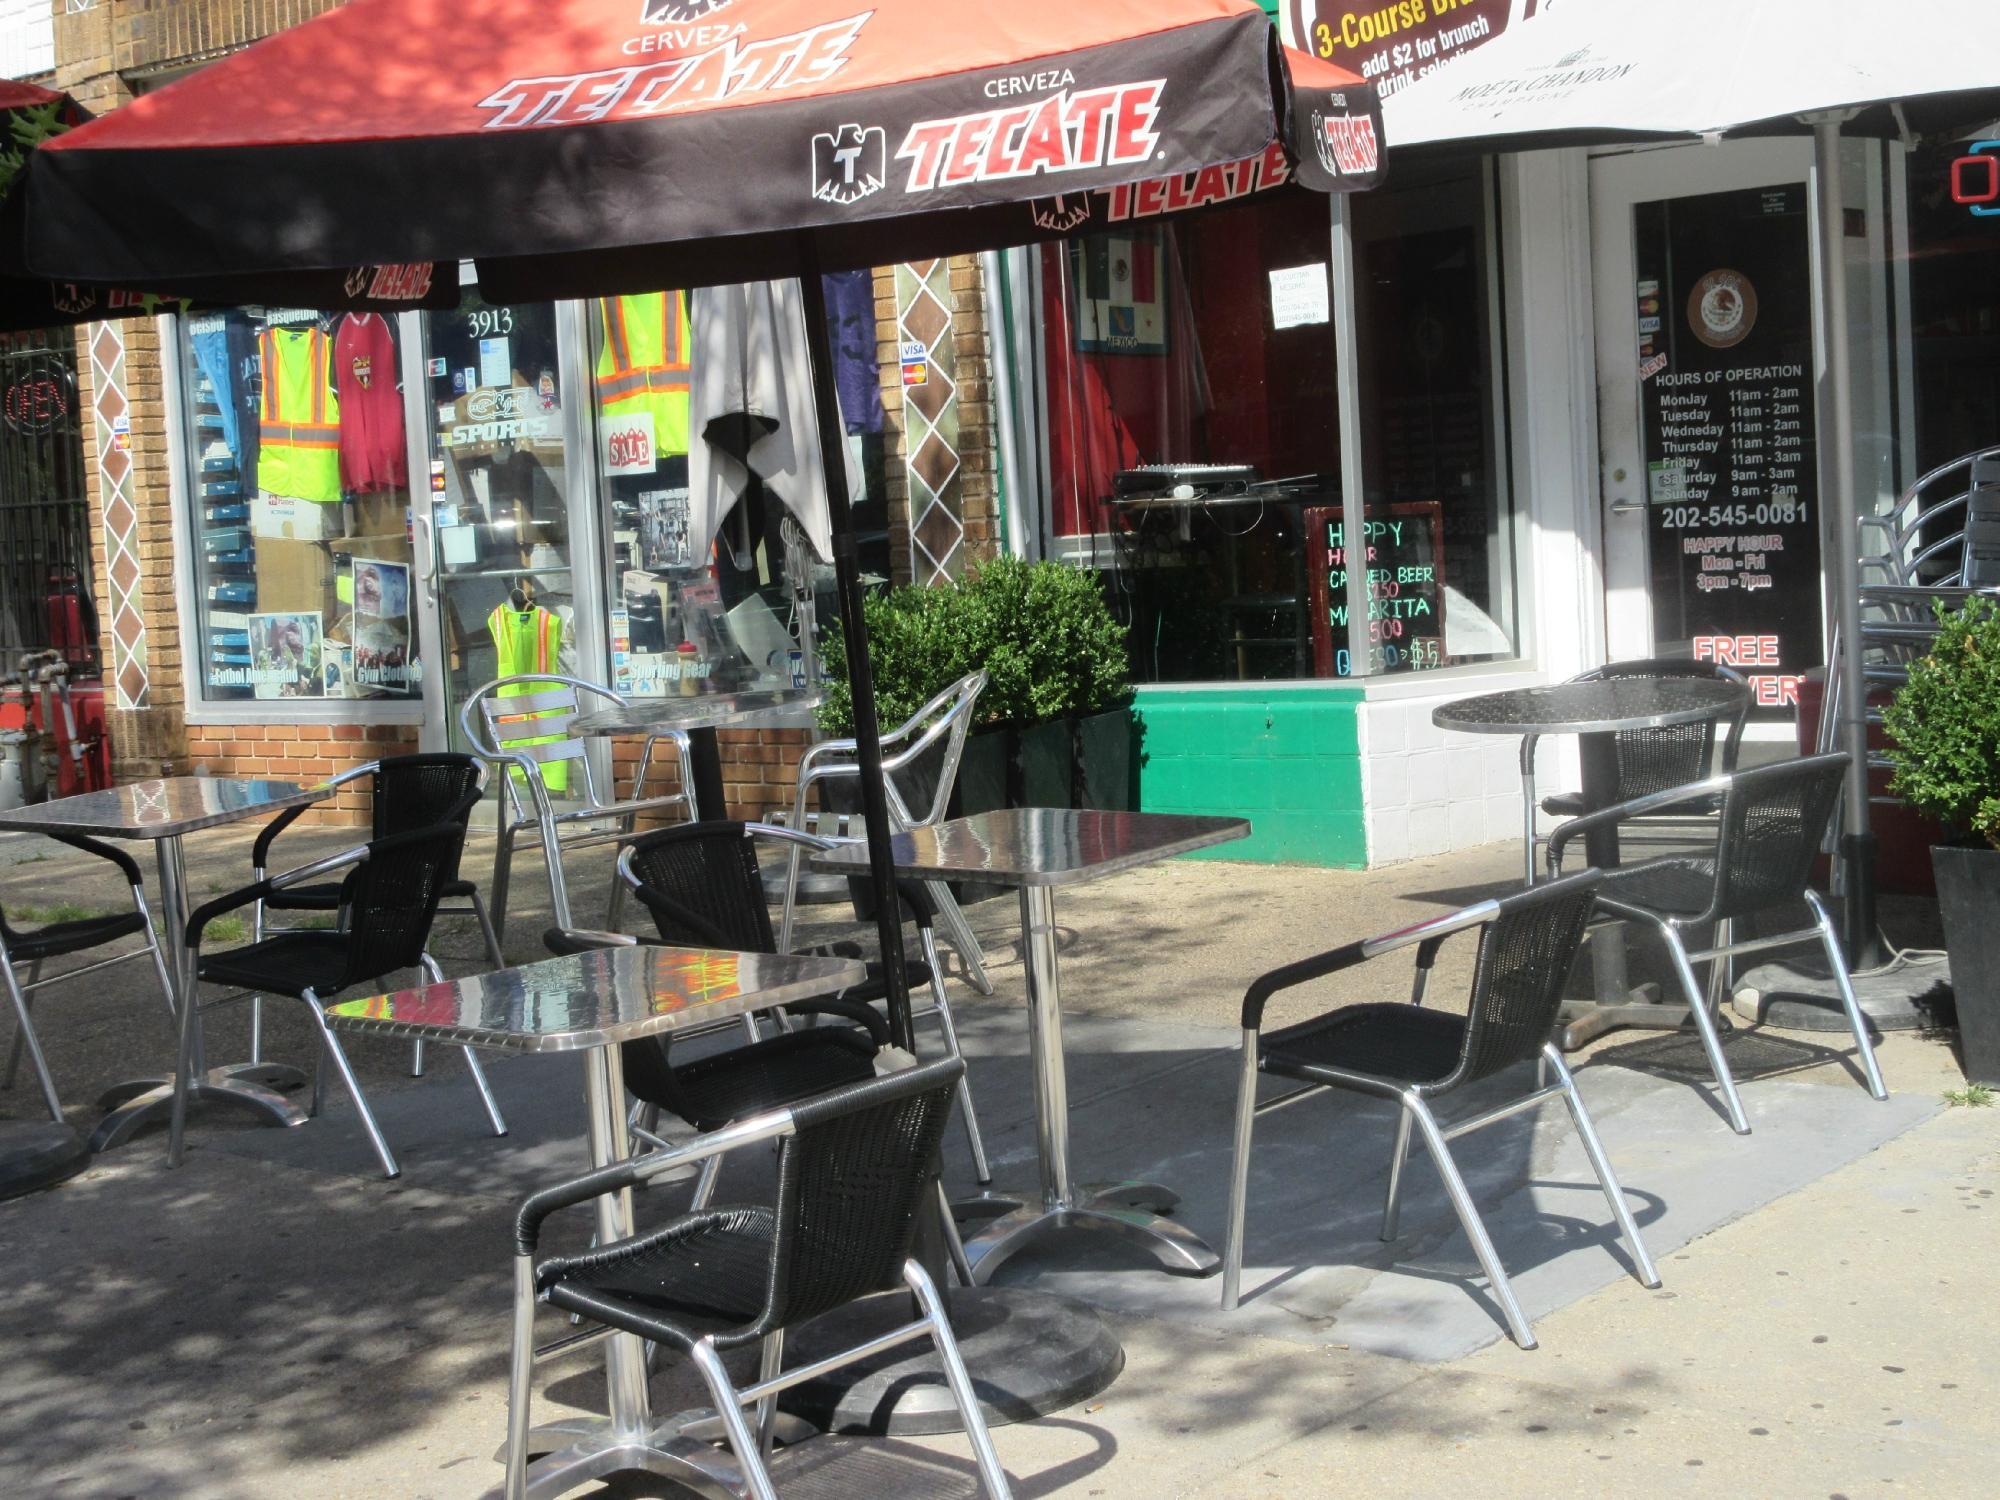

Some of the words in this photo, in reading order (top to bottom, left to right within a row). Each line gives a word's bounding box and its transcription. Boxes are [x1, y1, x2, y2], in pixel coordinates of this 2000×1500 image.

[621, 22, 748, 56] CERVEZA
[1316, 0, 1427, 58] 3-Course
[1361, 50, 1390, 78] add
[1393, 43, 1414, 68] $2
[1416, 34, 1437, 60] for
[1438, 15, 1490, 51] brunch
[474, 8, 877, 129] TECATE
[984, 67, 1075, 98] CERVEZA
[1377, 67, 1415, 99] drink
[894, 78, 1168, 194] TECATE
[468, 307, 513, 338] 3913
[1641, 318, 1660, 330] VISA
[904, 344, 924, 356] VISA
[1106, 335, 1139, 349] MEXICO
[1640, 353, 1668, 381] NEW
[1656, 371, 1701, 387] HOURS
[1705, 370, 1722, 384] OF
[1726, 364, 1802, 382] OPERATION
[1660, 392, 1708, 407] Monday
[1729, 389, 1761, 402] 11am
[1772, 386, 1799, 399] 2am
[1661, 408, 1711, 423] Tuesday
[1730, 405, 1762, 417] 11am
[1773, 402, 1800, 415] 2am
[452, 417, 549, 446] SPORTS
[1661, 424, 1724, 438] Wedneday
[1730, 421, 1762, 433] 11am
[1774, 418, 1800, 431] 2am
[610, 438, 650, 463] SALE
[1662, 439, 1719, 453] Thursday
[1731, 437, 1763, 449] 11am
[1774, 434, 1801, 446] 2am
[1662, 456, 1701, 470] Friday
[1731, 453, 1763, 465] 11am
[1775, 450, 1801, 463] 3am
[1663, 471, 1717, 485] Saturday
[1731, 469, 1758, 481] 9am
[1769, 467, 1796, 480] 3am
[1664, 487, 1709, 501] Sunday
[1771, 483, 1798, 495] 2am
[1661, 502, 1808, 528] 202-545-0081
[1328, 522, 1402, 547] HPPY
[1684, 537, 1736, 554] HAPPY
[1737, 534, 1785, 552] HOUR
[1328, 546, 1377, 566] HR
[1702, 555, 1734, 571] Mon
[1744, 554, 1766, 570] Fri
[1397, 566, 1434, 584] BEER
[1697, 573, 1729, 592] 3pm
[1739, 572, 1773, 592] 7pm
[1693, 635, 1780, 667] FREE
[213, 667, 245, 685] Futbol
[357, 667, 380, 683] Gym
[631, 661, 681, 681] Sporting
[685, 661, 712, 679] Gear
